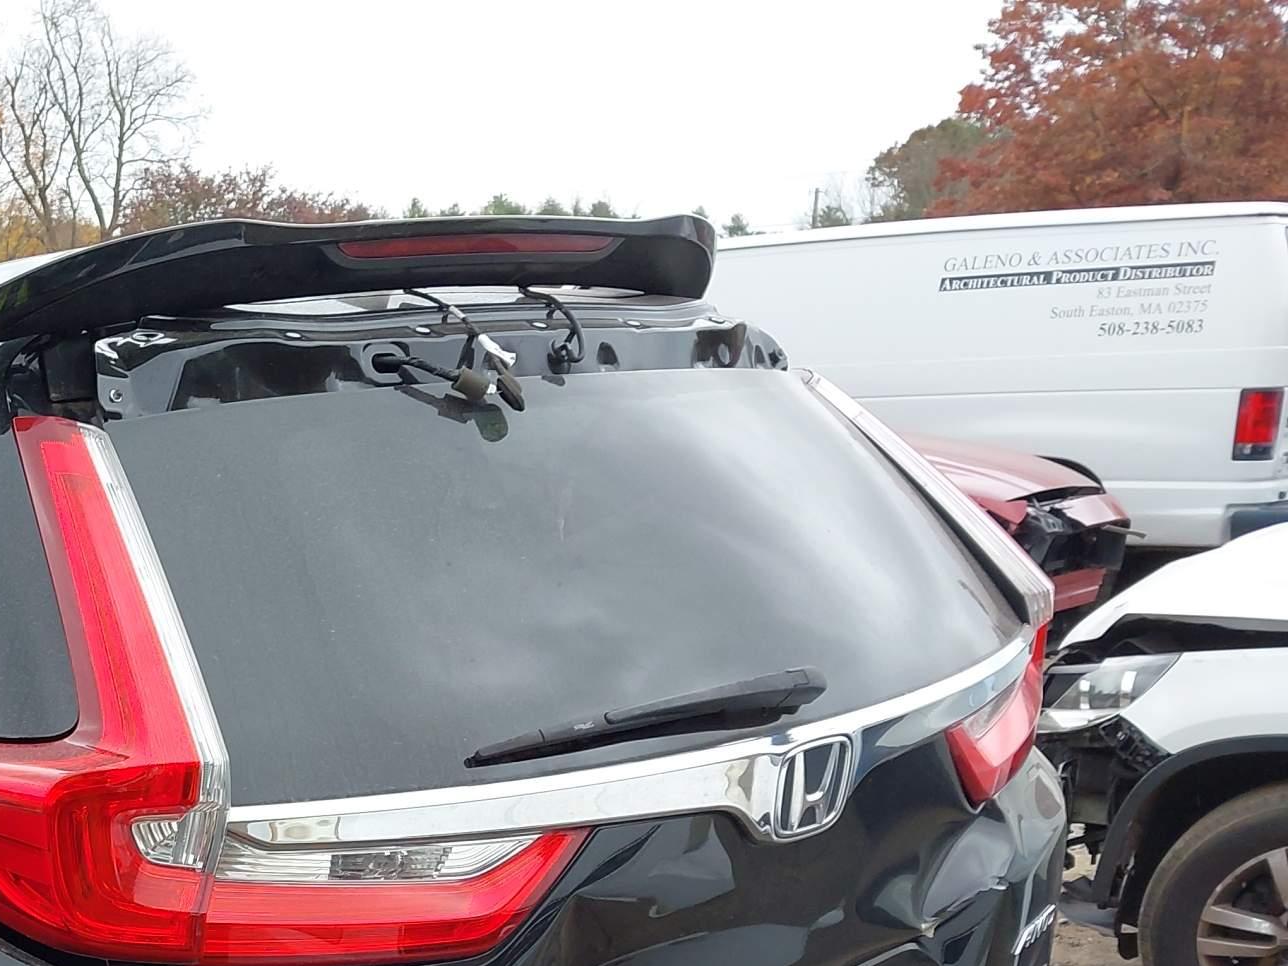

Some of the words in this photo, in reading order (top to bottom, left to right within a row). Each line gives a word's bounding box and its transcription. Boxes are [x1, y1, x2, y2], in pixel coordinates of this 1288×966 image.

[943, 252, 1023, 272] GALENO
[1027, 251, 1042, 267] &
[1047, 243, 1171, 265] ASSOCIATES
[1177, 239, 1220, 257] INC.
[1096, 286, 1112, 300] 83
[1116, 285, 1170, 299] Eastman
[1174, 282, 1212, 296] Street
[1050, 306, 1085, 320] South
[1089, 304, 1134, 318] Easton,
[1139, 301, 1164, 316] MA
[1167, 300, 1209, 314] 02375
[1097, 318, 1205, 337] 508-238-5083
